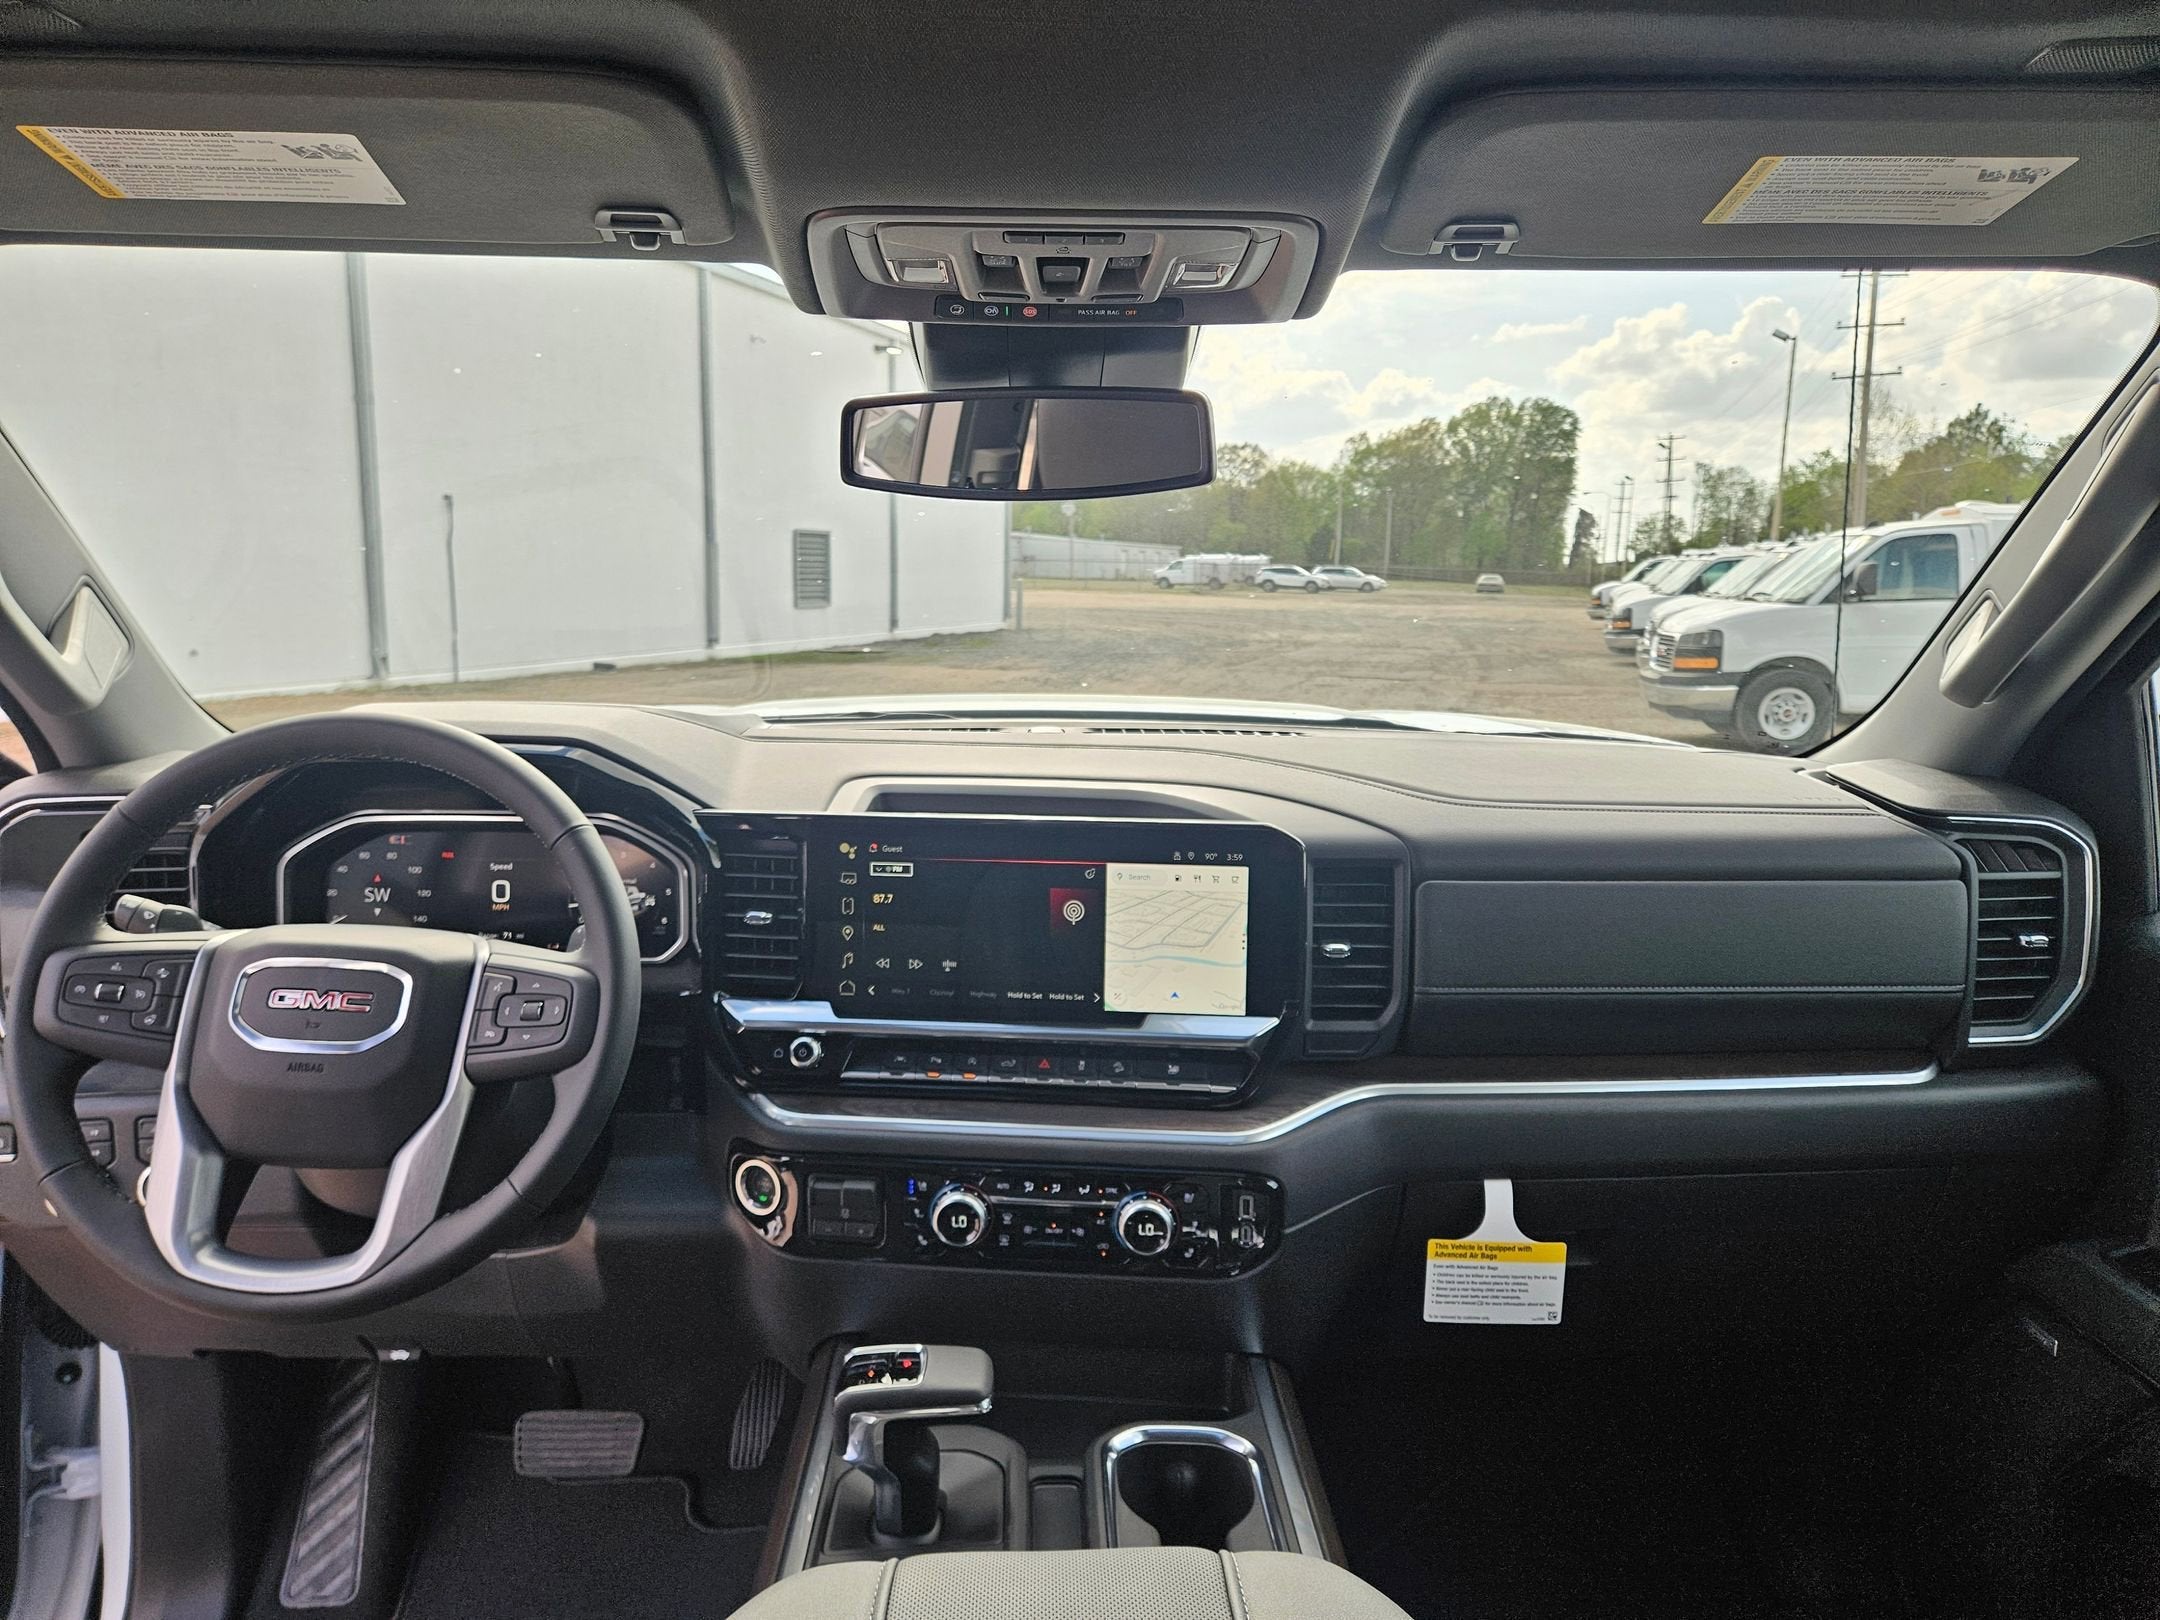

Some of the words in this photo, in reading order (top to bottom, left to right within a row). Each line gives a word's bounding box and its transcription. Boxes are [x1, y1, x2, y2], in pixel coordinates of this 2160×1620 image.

[1226, 853, 1243, 861] 3:59
[408, 866, 422, 874] 100
[490, 862, 513, 872] Speed
[364, 887, 391, 903] SW
[491, 879, 510, 903] 0
[872, 894, 894, 903] 87.7
[1007, 991, 1023, 999] Hold
[268, 989, 374, 1012] GMC
[287, 1062, 324, 1073] AIRBAG
[1485, 1244, 1516, 1253] Equipped
[1480, 1252, 1497, 1260] Bags
